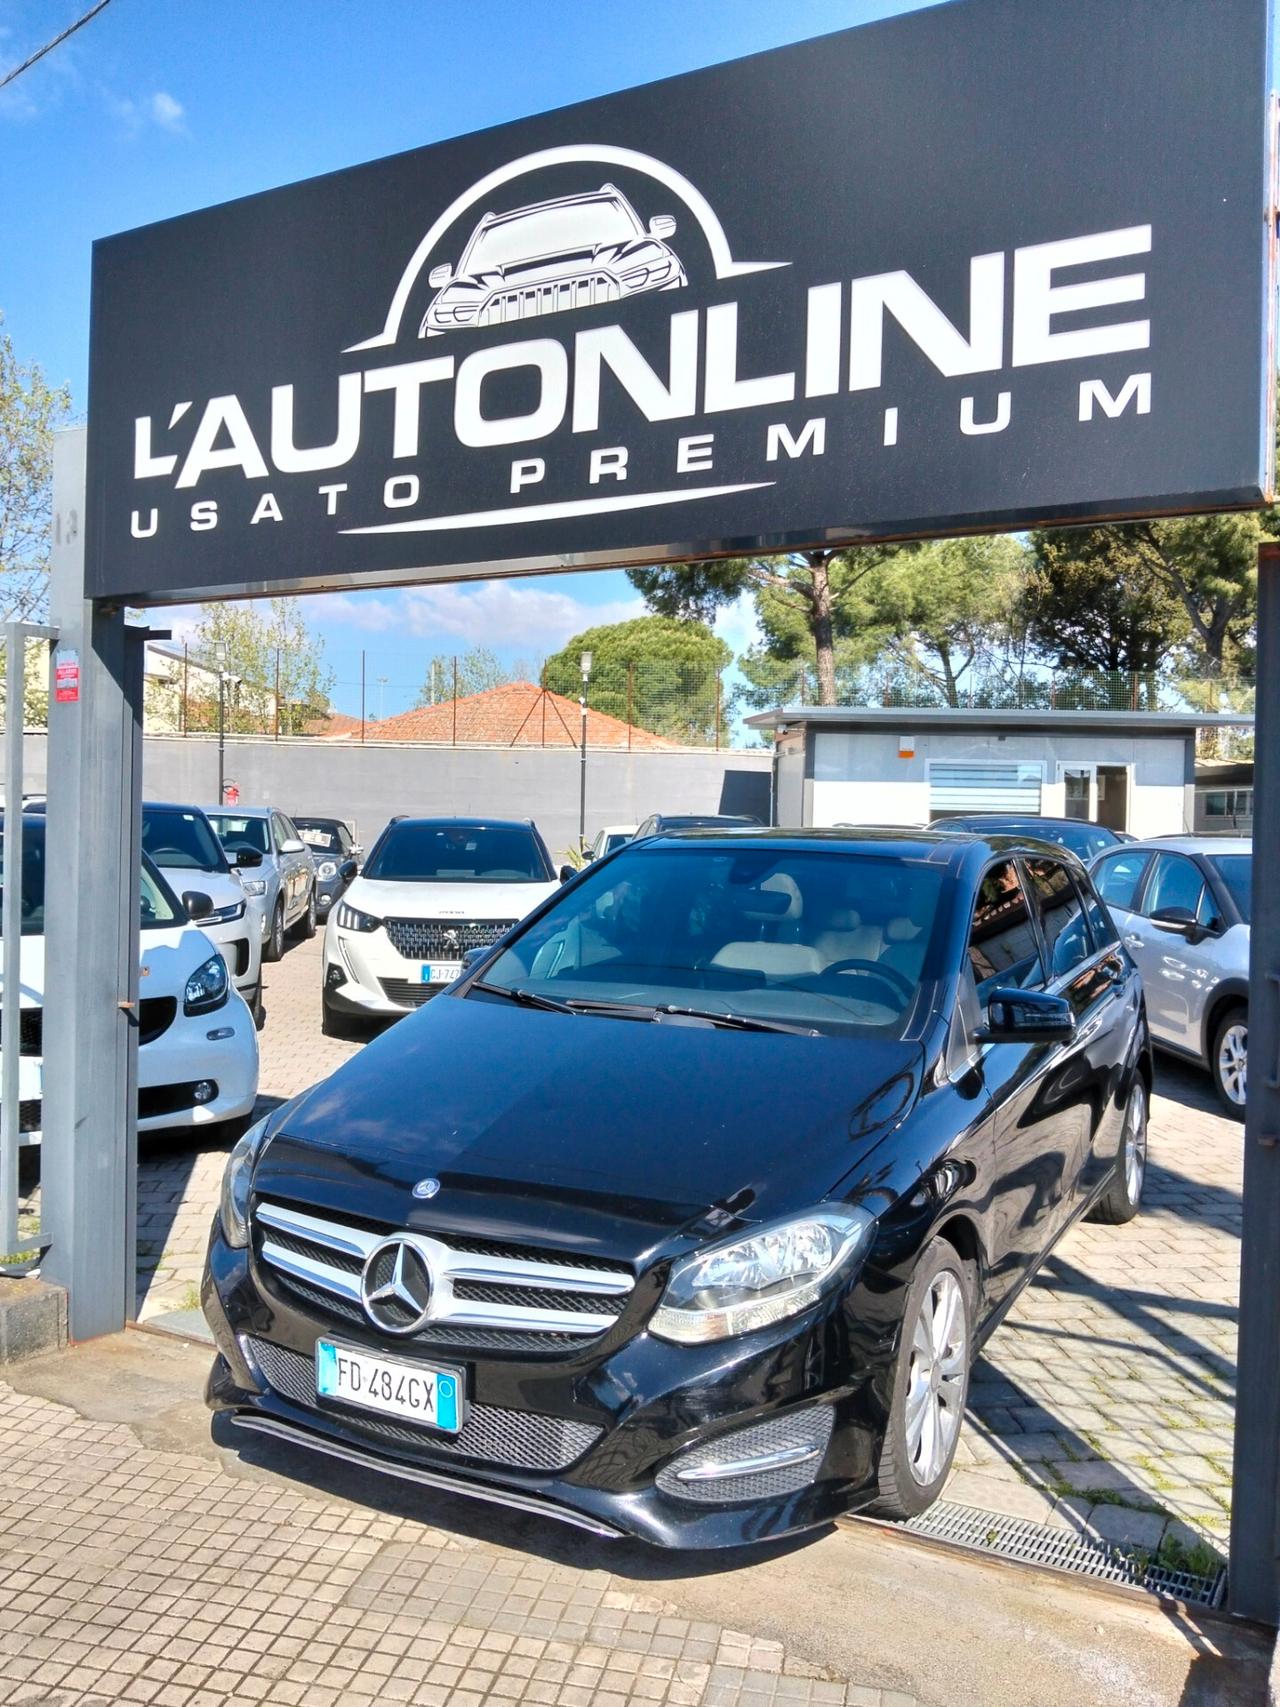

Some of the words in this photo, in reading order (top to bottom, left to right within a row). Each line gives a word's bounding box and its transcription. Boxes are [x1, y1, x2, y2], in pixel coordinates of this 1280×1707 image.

[134, 224, 1152, 489] L'AUTONLINE
[131, 474, 420, 538] USATO
[510, 372, 1152, 494] PREMIUM
[338, 1358, 361, 1391] FD
[368, 1368, 434, 1413] 484GX
